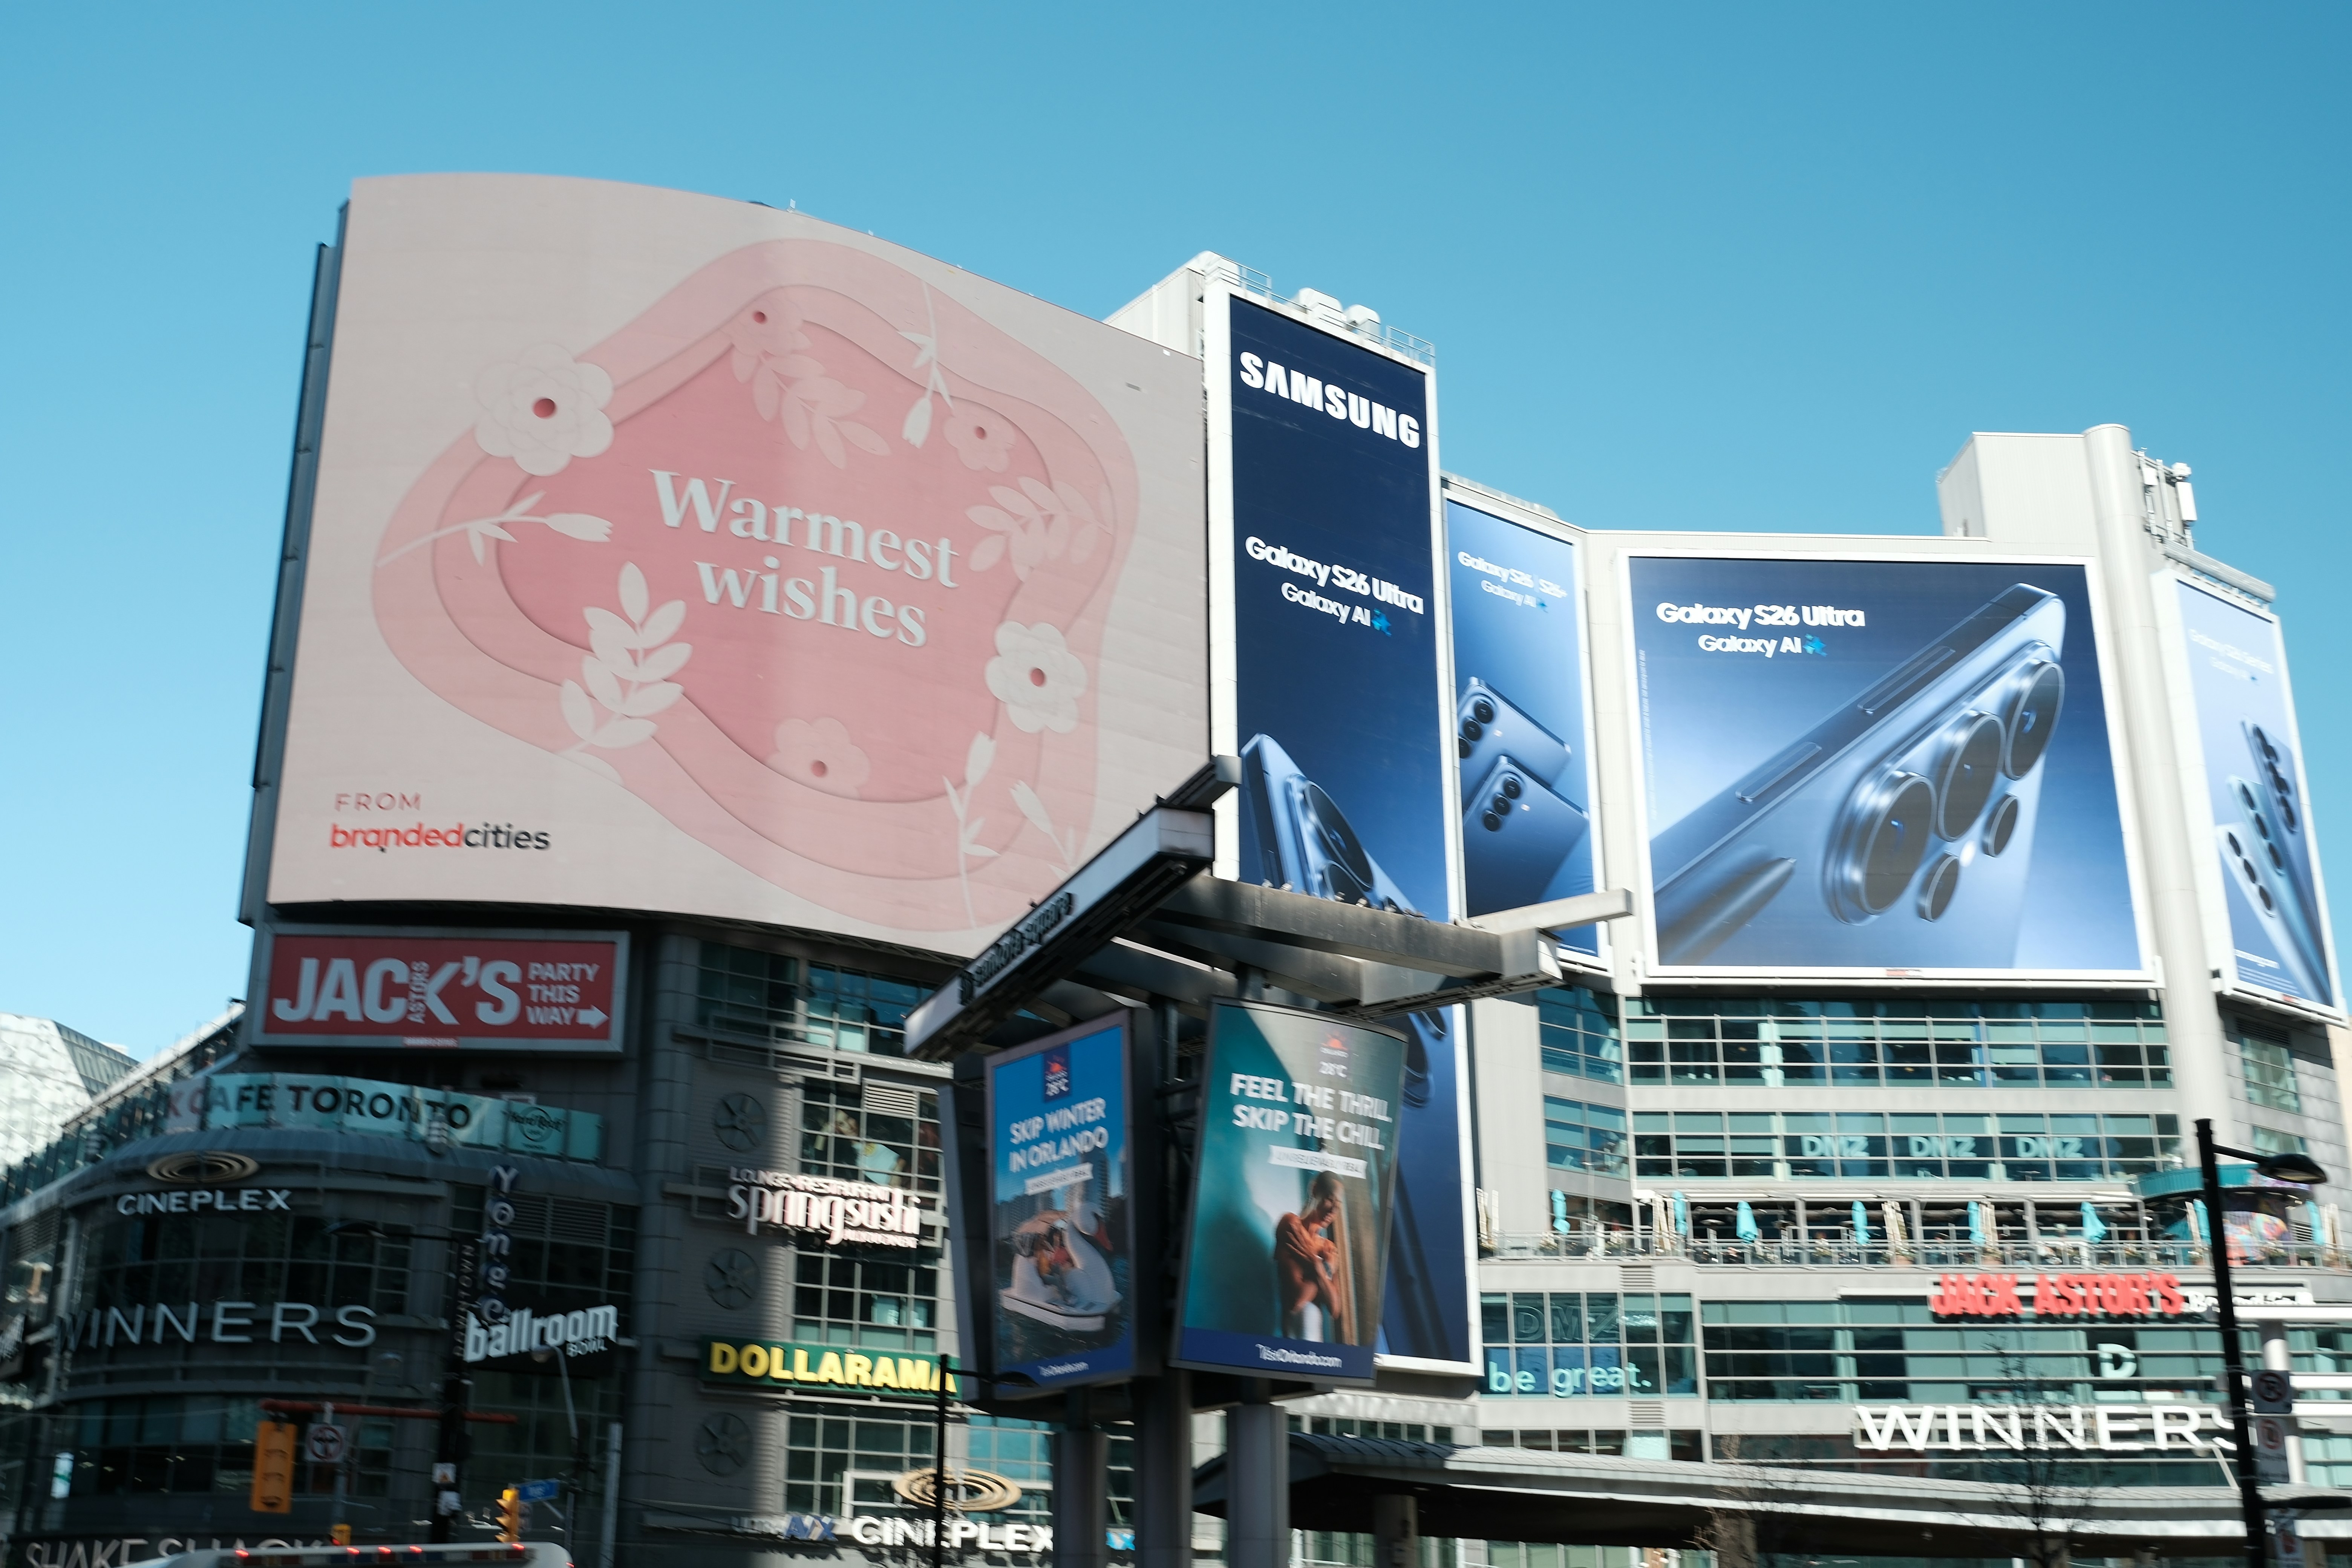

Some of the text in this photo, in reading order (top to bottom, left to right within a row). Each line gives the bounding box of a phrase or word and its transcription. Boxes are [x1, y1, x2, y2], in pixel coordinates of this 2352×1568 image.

[1239, 351, 1421, 449] SAMSUNG
[648, 469, 960, 588] Warmest
[1245, 536, 1424, 615] Galaxy S26 Ultra
[1457, 551, 1510, 583] Galaxy
[693, 555, 927, 647] wishes
[1281, 582, 1371, 627] Galaxy AI
[1656, 602, 1866, 630] Galaxy S26 Ultra
[1698, 634, 1802, 658] Galaxy AI
[334, 792, 422, 812] FROM
[329, 821, 551, 851] brandedcities
[273, 956, 522, 1026] JACK'S
[527, 962, 600, 982] PARTY
[527, 983, 580, 1003] THIS
[526, 1006, 577, 1026] WAY
[286, 1084, 471, 1130] TORONTO
[1230, 1072, 1393, 1124] FEEL THE THRILL
[1009, 1096, 1107, 1145] SKIP WINTER
[1232, 1104, 1385, 1151] SKIP THE CHILL
[1009, 1125, 1109, 1173] IN ORLANDO
[1801, 1136, 1870, 1157] DMZ
[1908, 1136, 1977, 1158] DMZ
[2015, 1136, 2084, 1158] DMZ
[116, 1189, 292, 1216] CINEPLEX
[1929, 1273, 2023, 1316] JACK
[463, 1305, 619, 1363] ballroom
[709, 1341, 957, 1393] DOLLARAMA
[1488, 1361, 1652, 1398] be great.
[851, 1515, 1054, 1552] CINEPLEX
